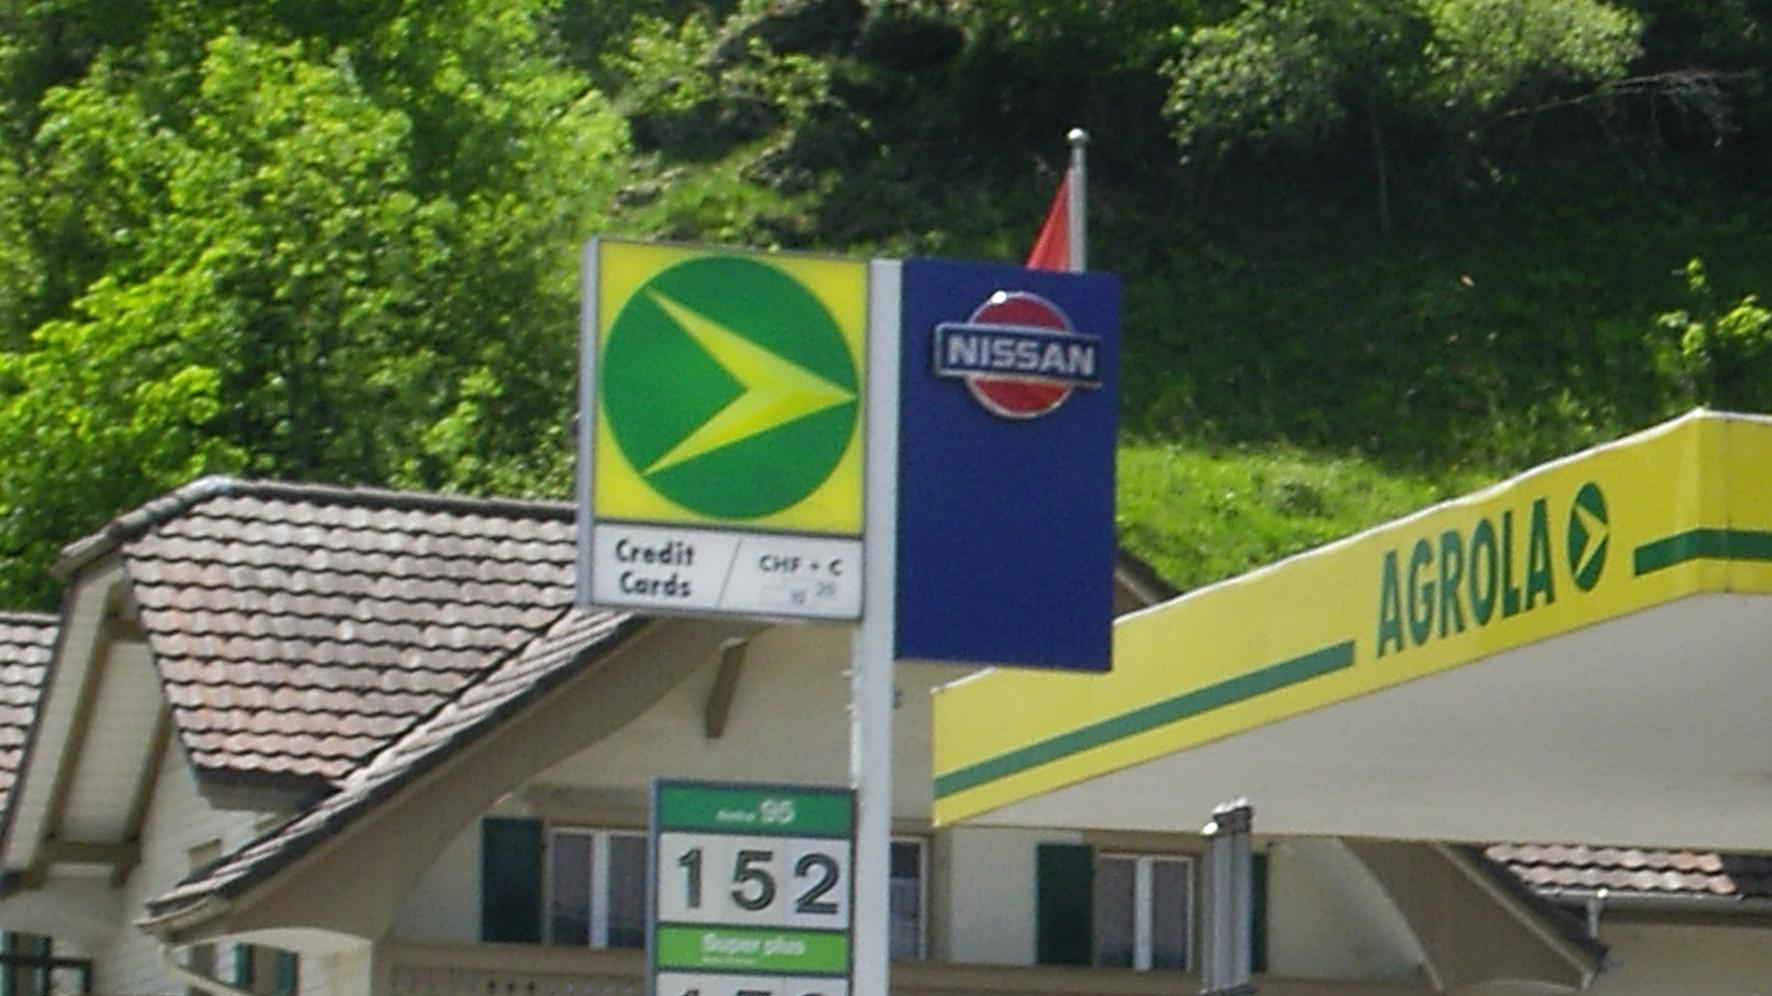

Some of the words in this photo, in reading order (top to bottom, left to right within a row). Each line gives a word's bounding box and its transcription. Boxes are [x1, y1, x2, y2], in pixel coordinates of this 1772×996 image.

[948, 335, 1095, 376] NISSAN
[615, 539, 695, 565] Credit
[758, 555, 800, 574] CHF
[620, 571, 691, 597] Cards
[1376, 497, 1555, 659] AGROLA
[678, 848, 840, 916] 152
